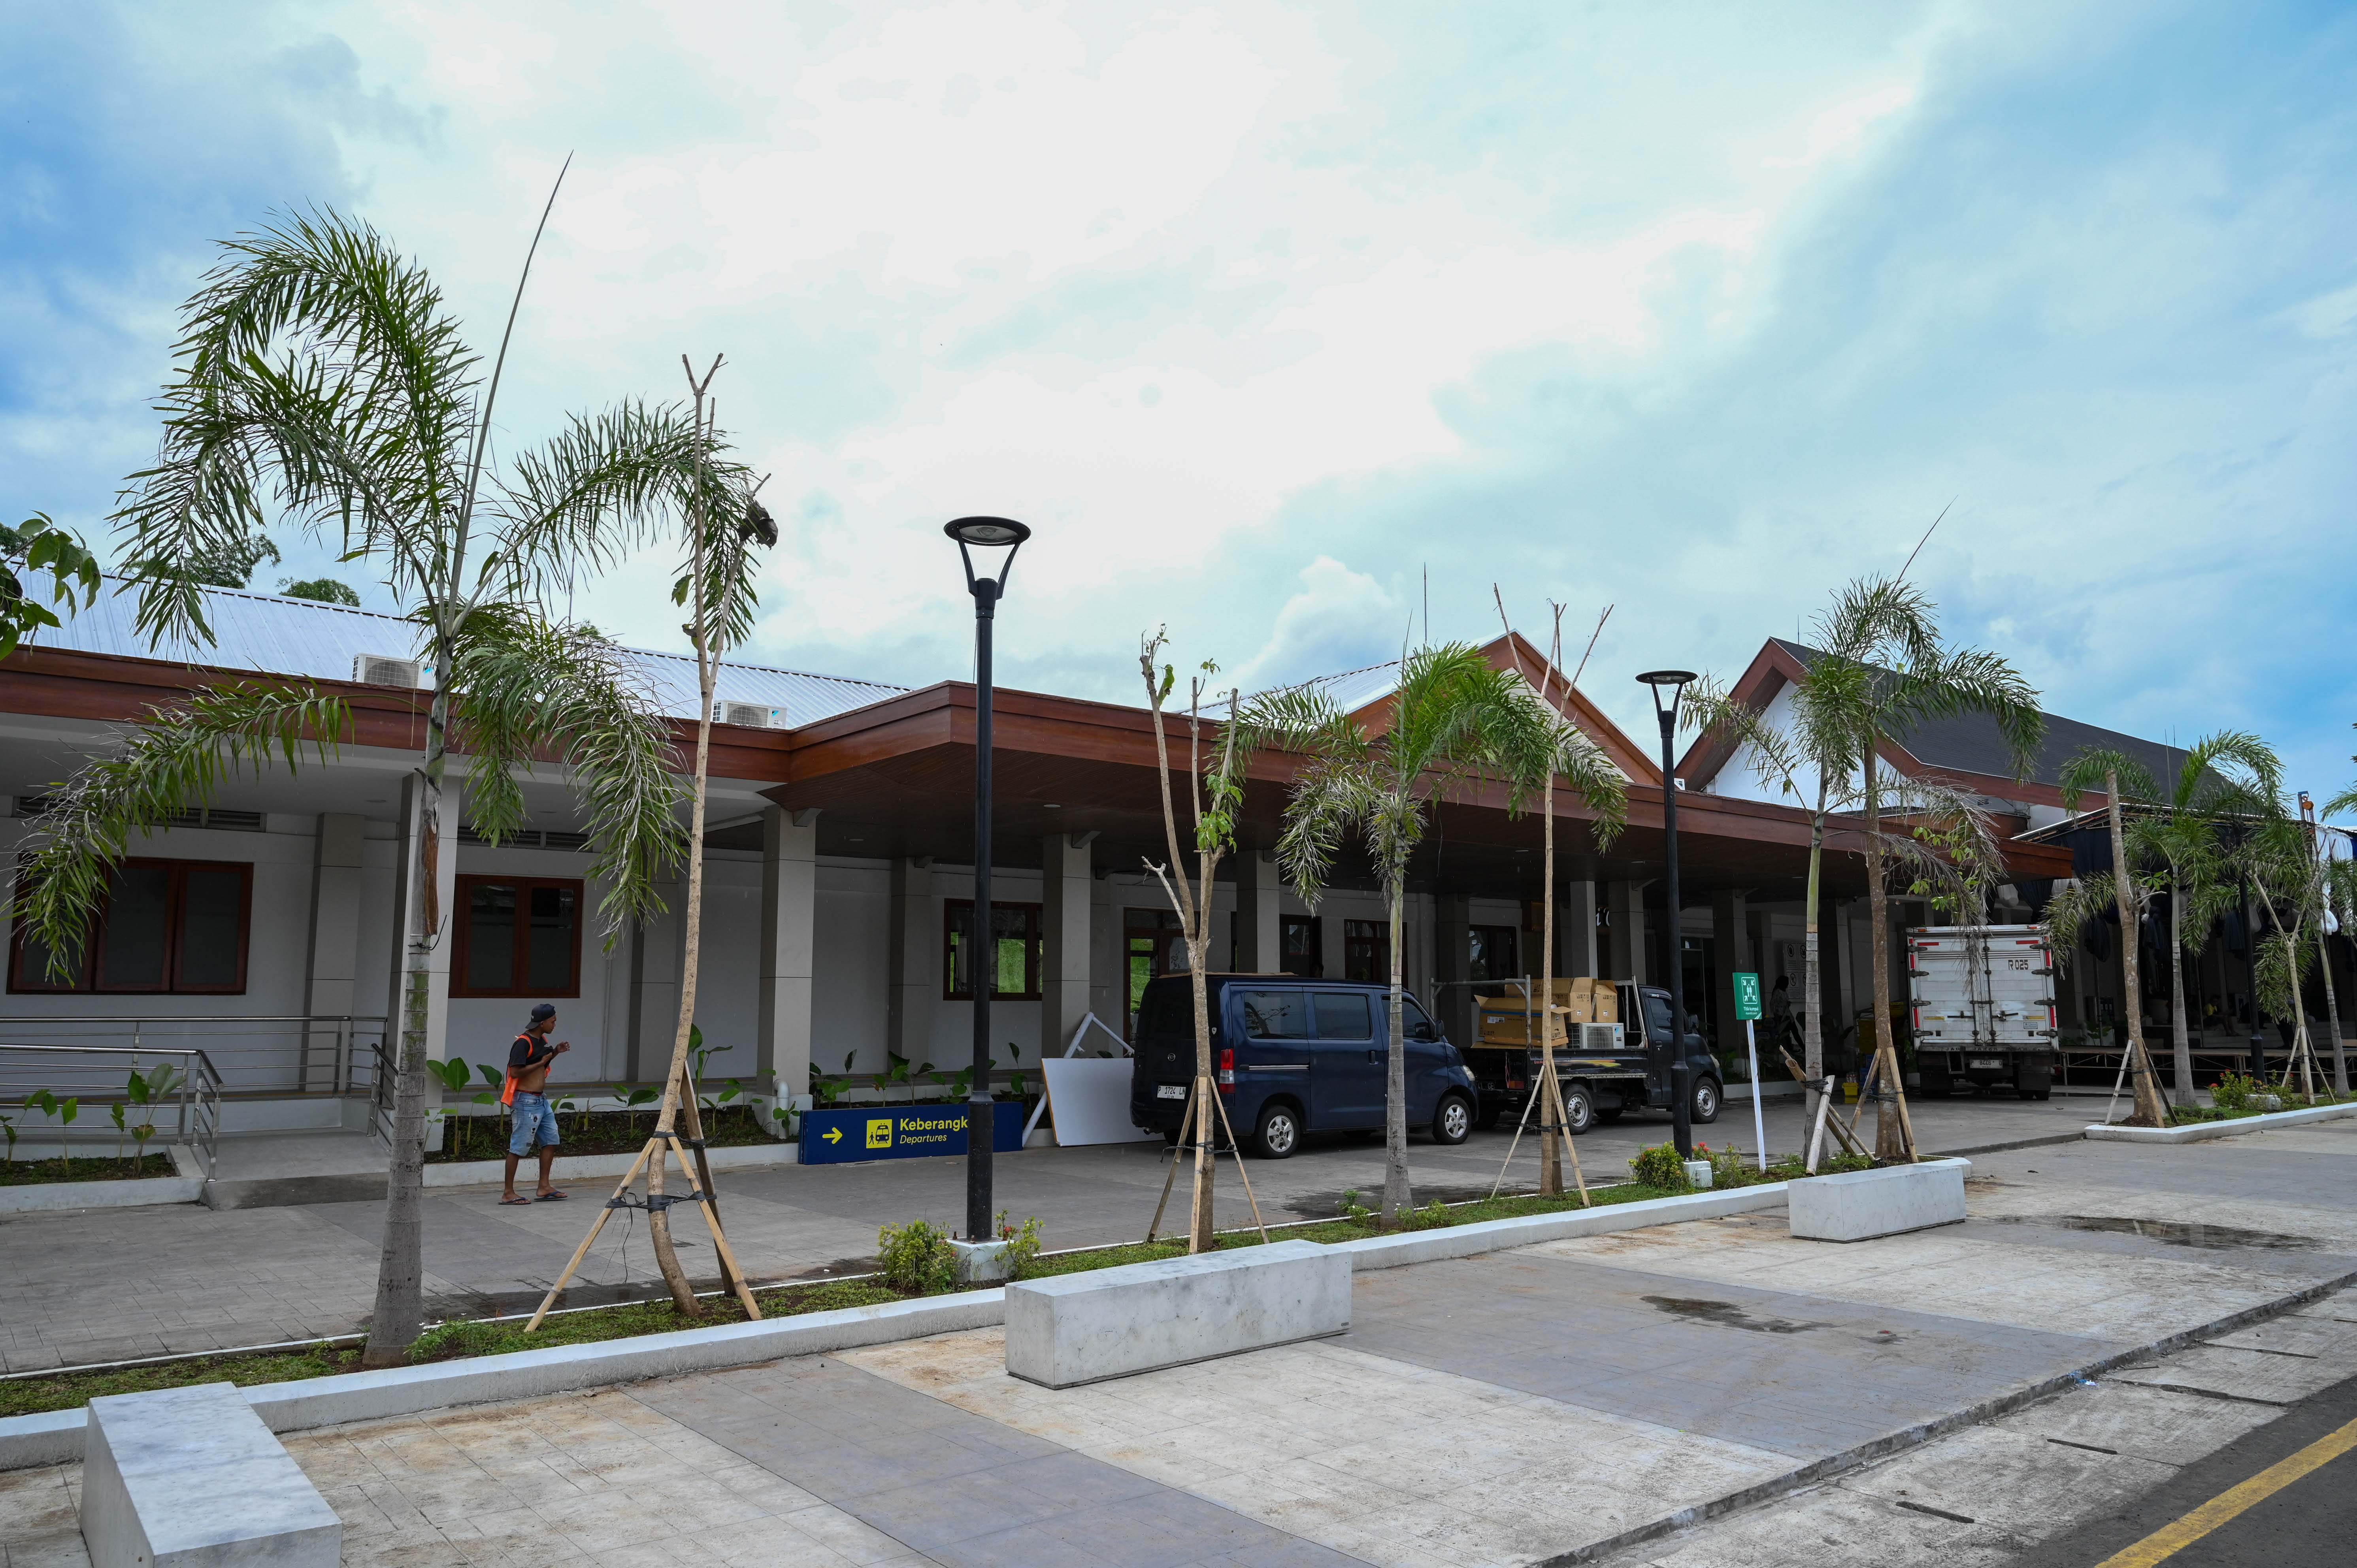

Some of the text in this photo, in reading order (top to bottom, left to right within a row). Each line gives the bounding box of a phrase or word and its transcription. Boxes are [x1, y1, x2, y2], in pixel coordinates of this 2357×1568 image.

[2008, 959, 2029, 970] R 025
[900, 1116, 968, 1131] Keberangk
[900, 1135, 947, 1145] Departures
